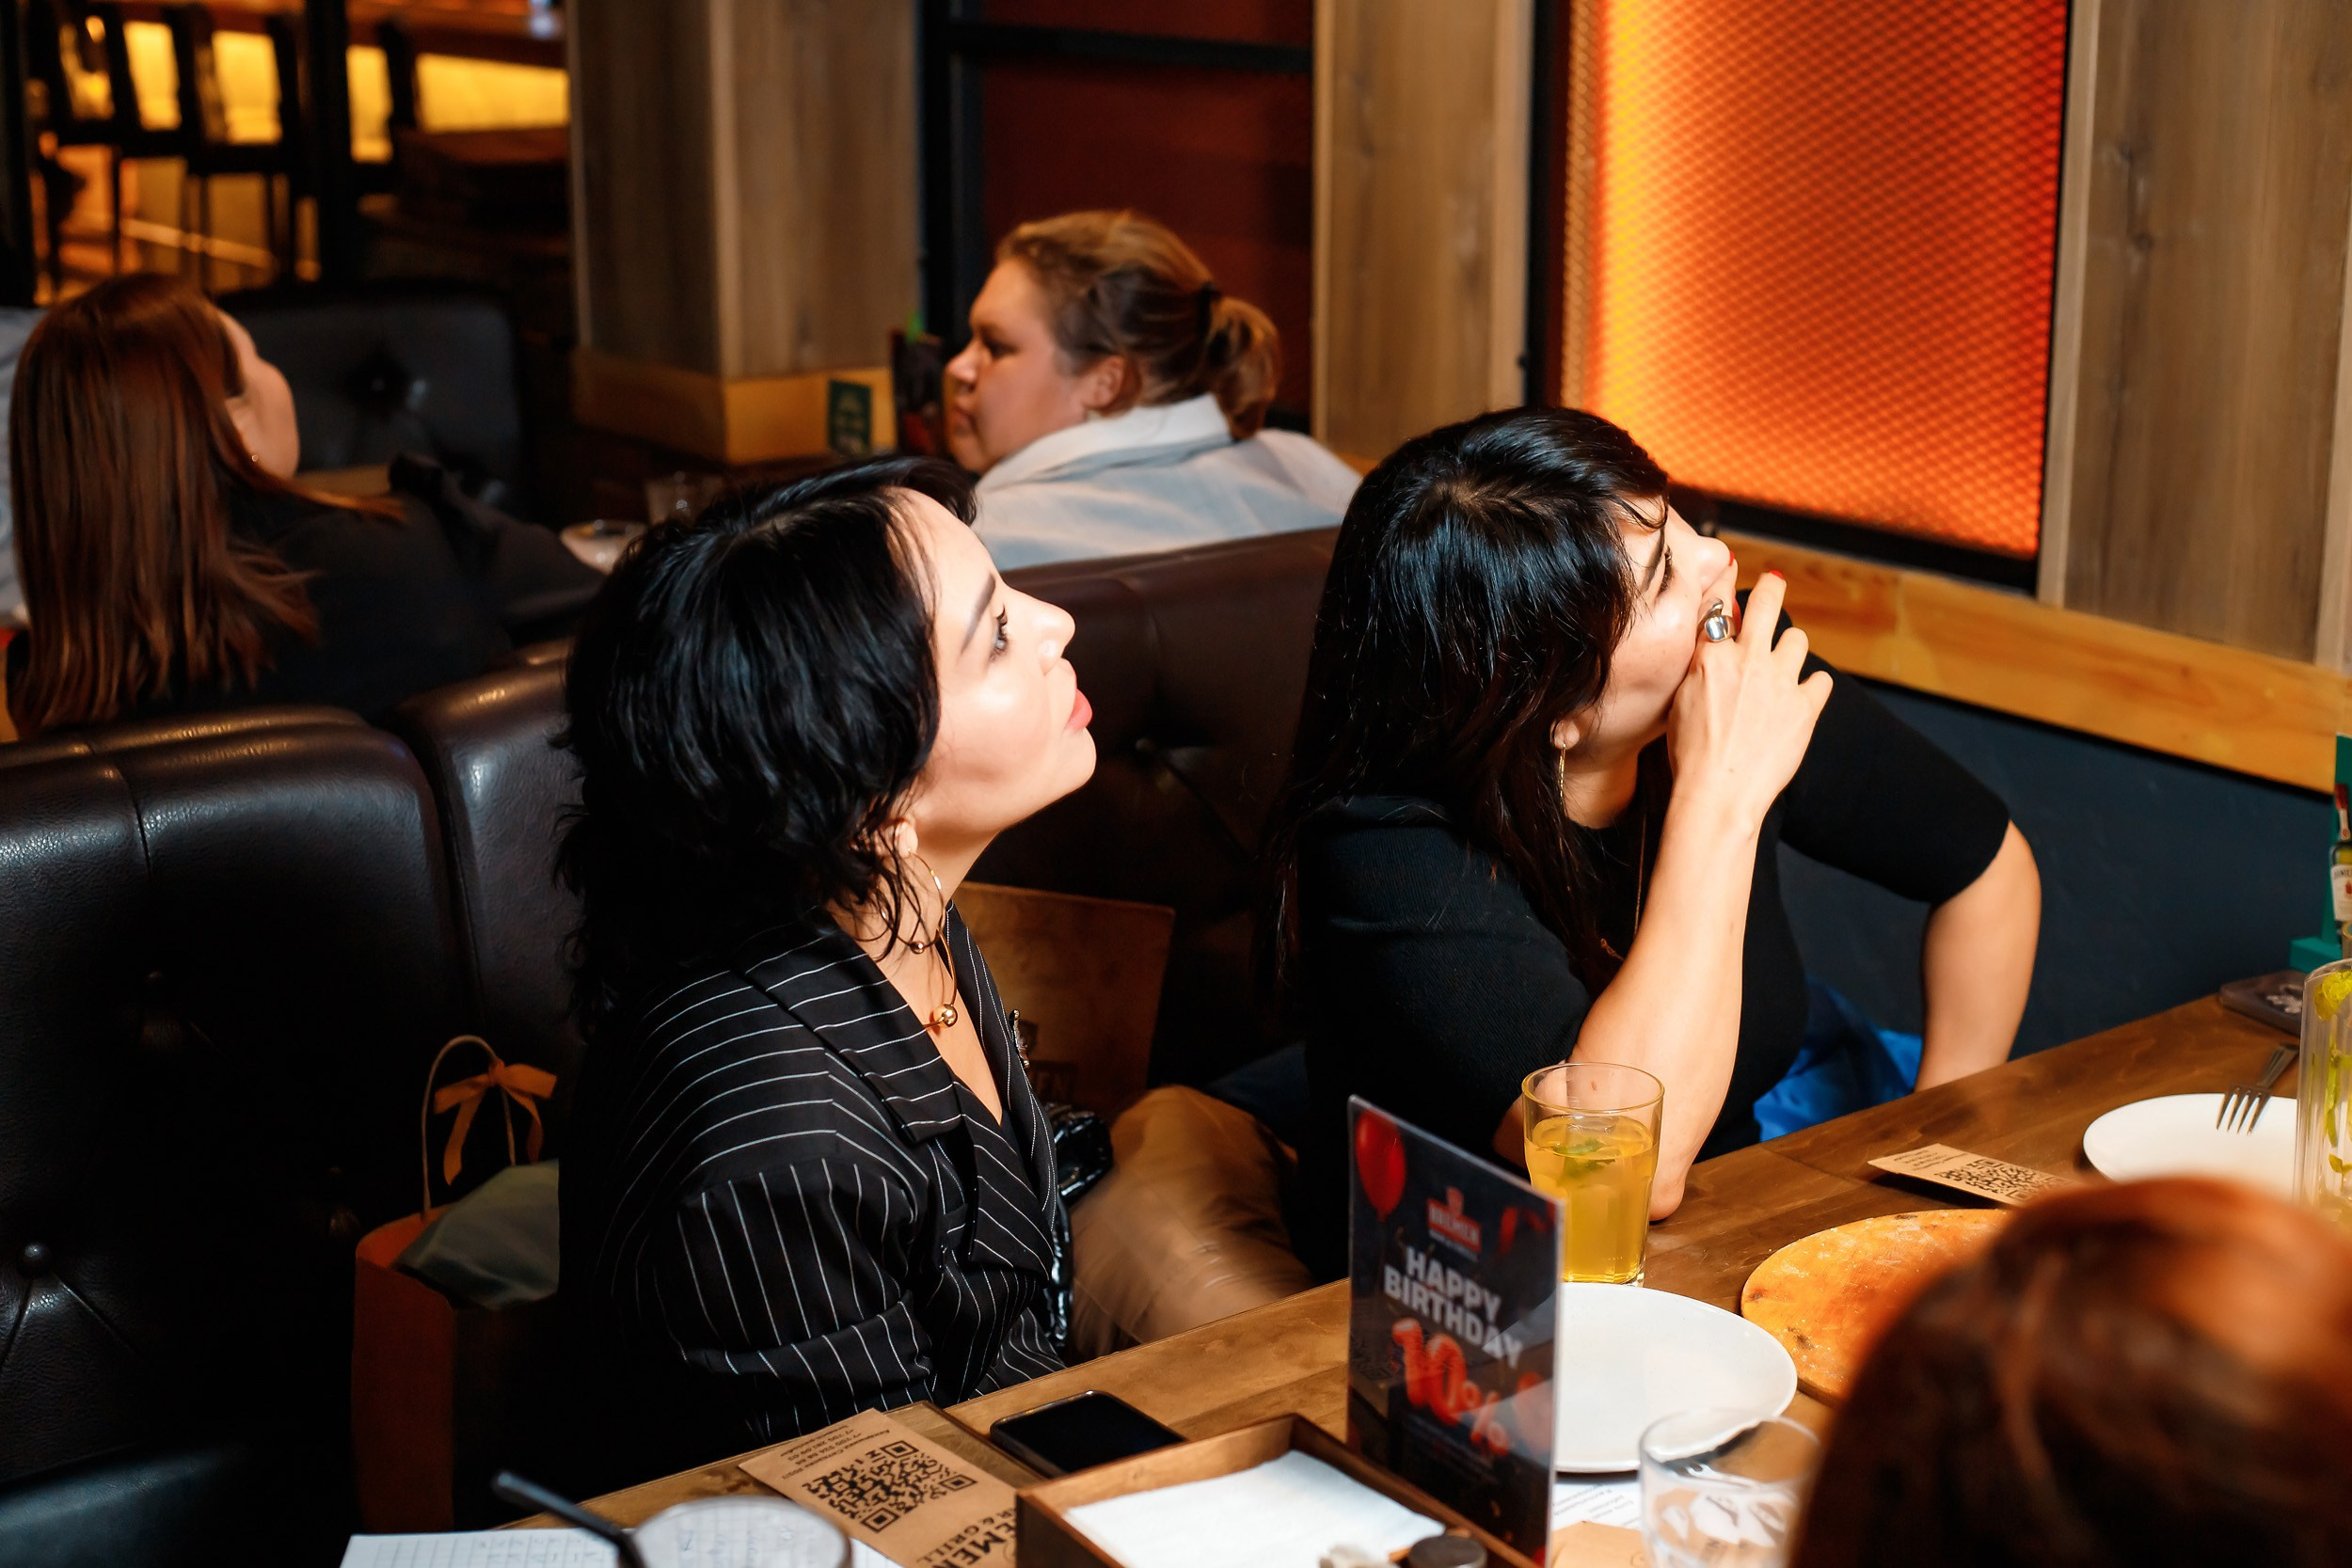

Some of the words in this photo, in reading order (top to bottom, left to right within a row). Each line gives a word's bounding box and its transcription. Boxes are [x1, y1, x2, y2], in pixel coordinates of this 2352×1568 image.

[1406, 1245, 1502, 1317] HAPPY
[1383, 1265, 1524, 1369] BIRTHDAY
[916, 1525, 979, 1563] GRILL
[932, 1522, 1016, 1568] EME
